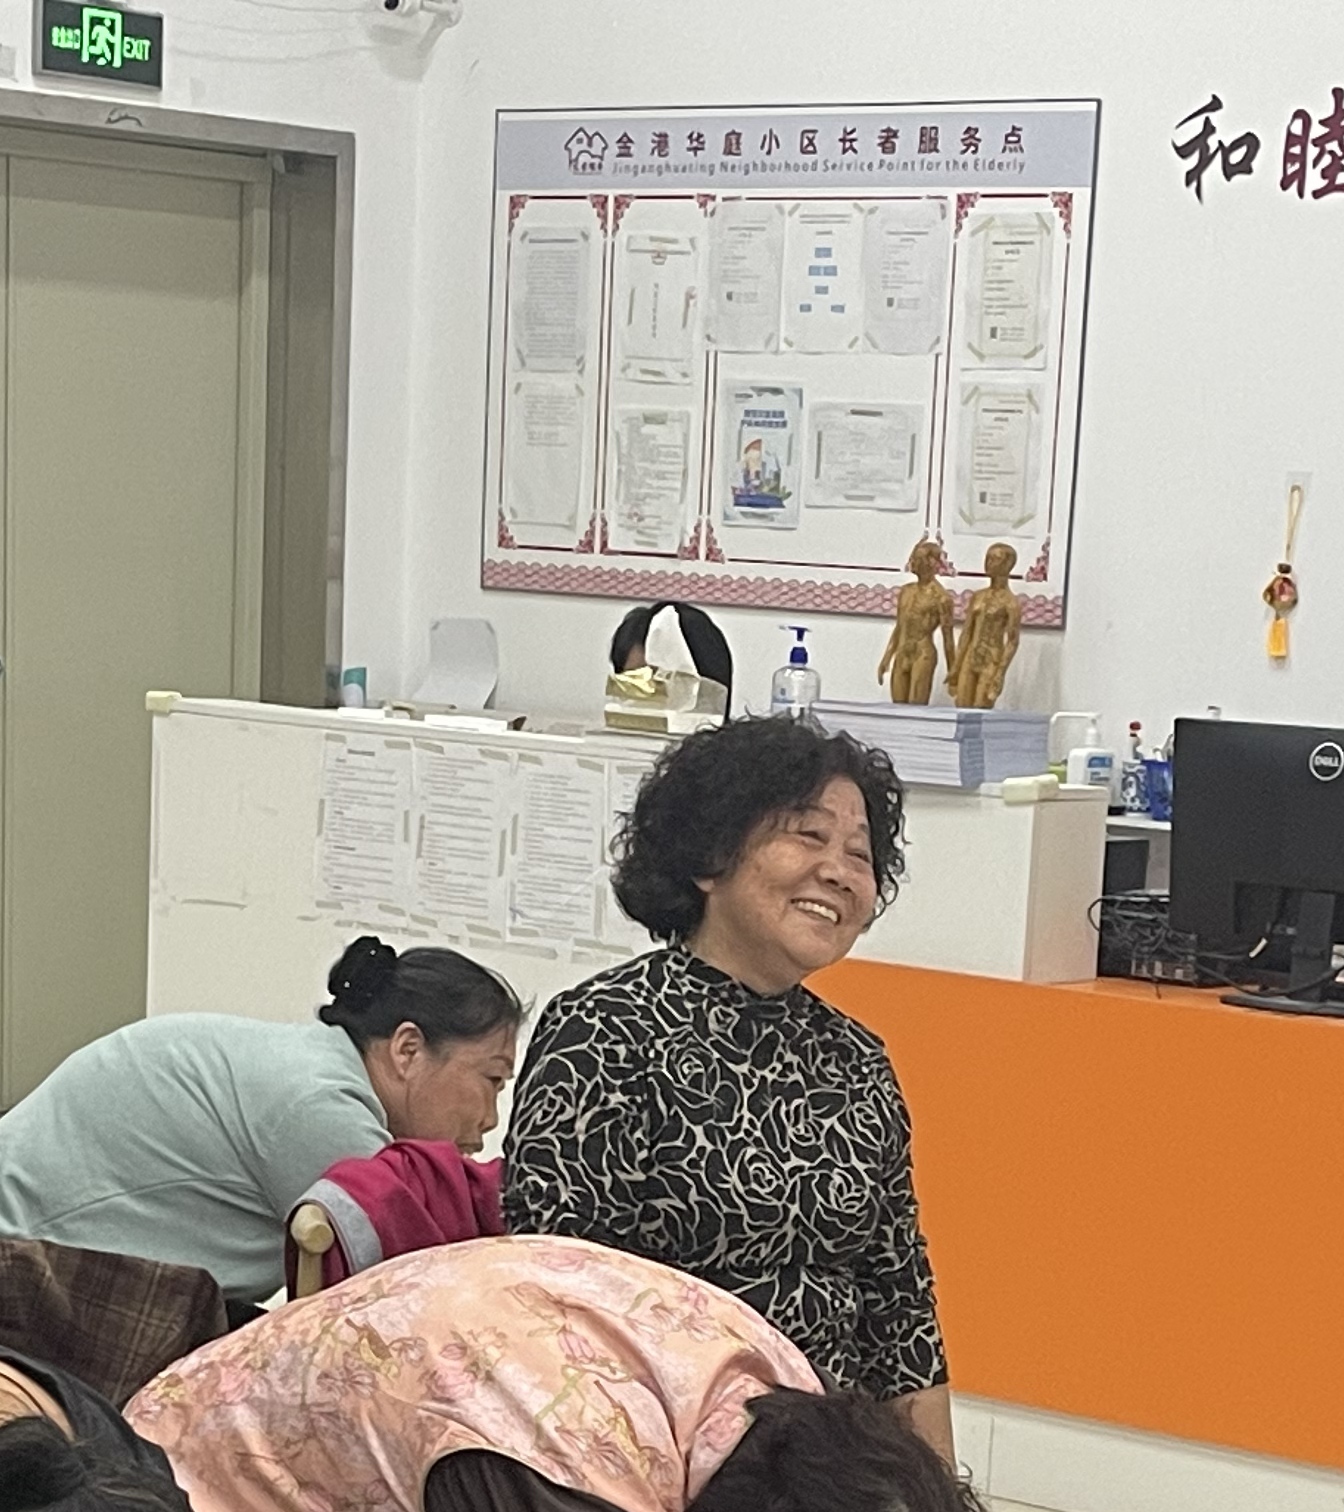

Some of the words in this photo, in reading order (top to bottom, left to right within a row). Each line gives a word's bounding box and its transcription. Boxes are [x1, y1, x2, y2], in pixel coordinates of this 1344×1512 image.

[122, 36, 150, 61] EXIT
[615, 124, 1025, 158] 金港华庭小区长者服务点
[720, 159, 818, 176] Neighborhood
[823, 158, 873, 173] Service
[878, 158, 916, 172] Point
[919, 158, 940, 172] for
[946, 157, 968, 172] the
[974, 157, 1026, 175] Elderly
[1314, 755, 1339, 767] DELL
